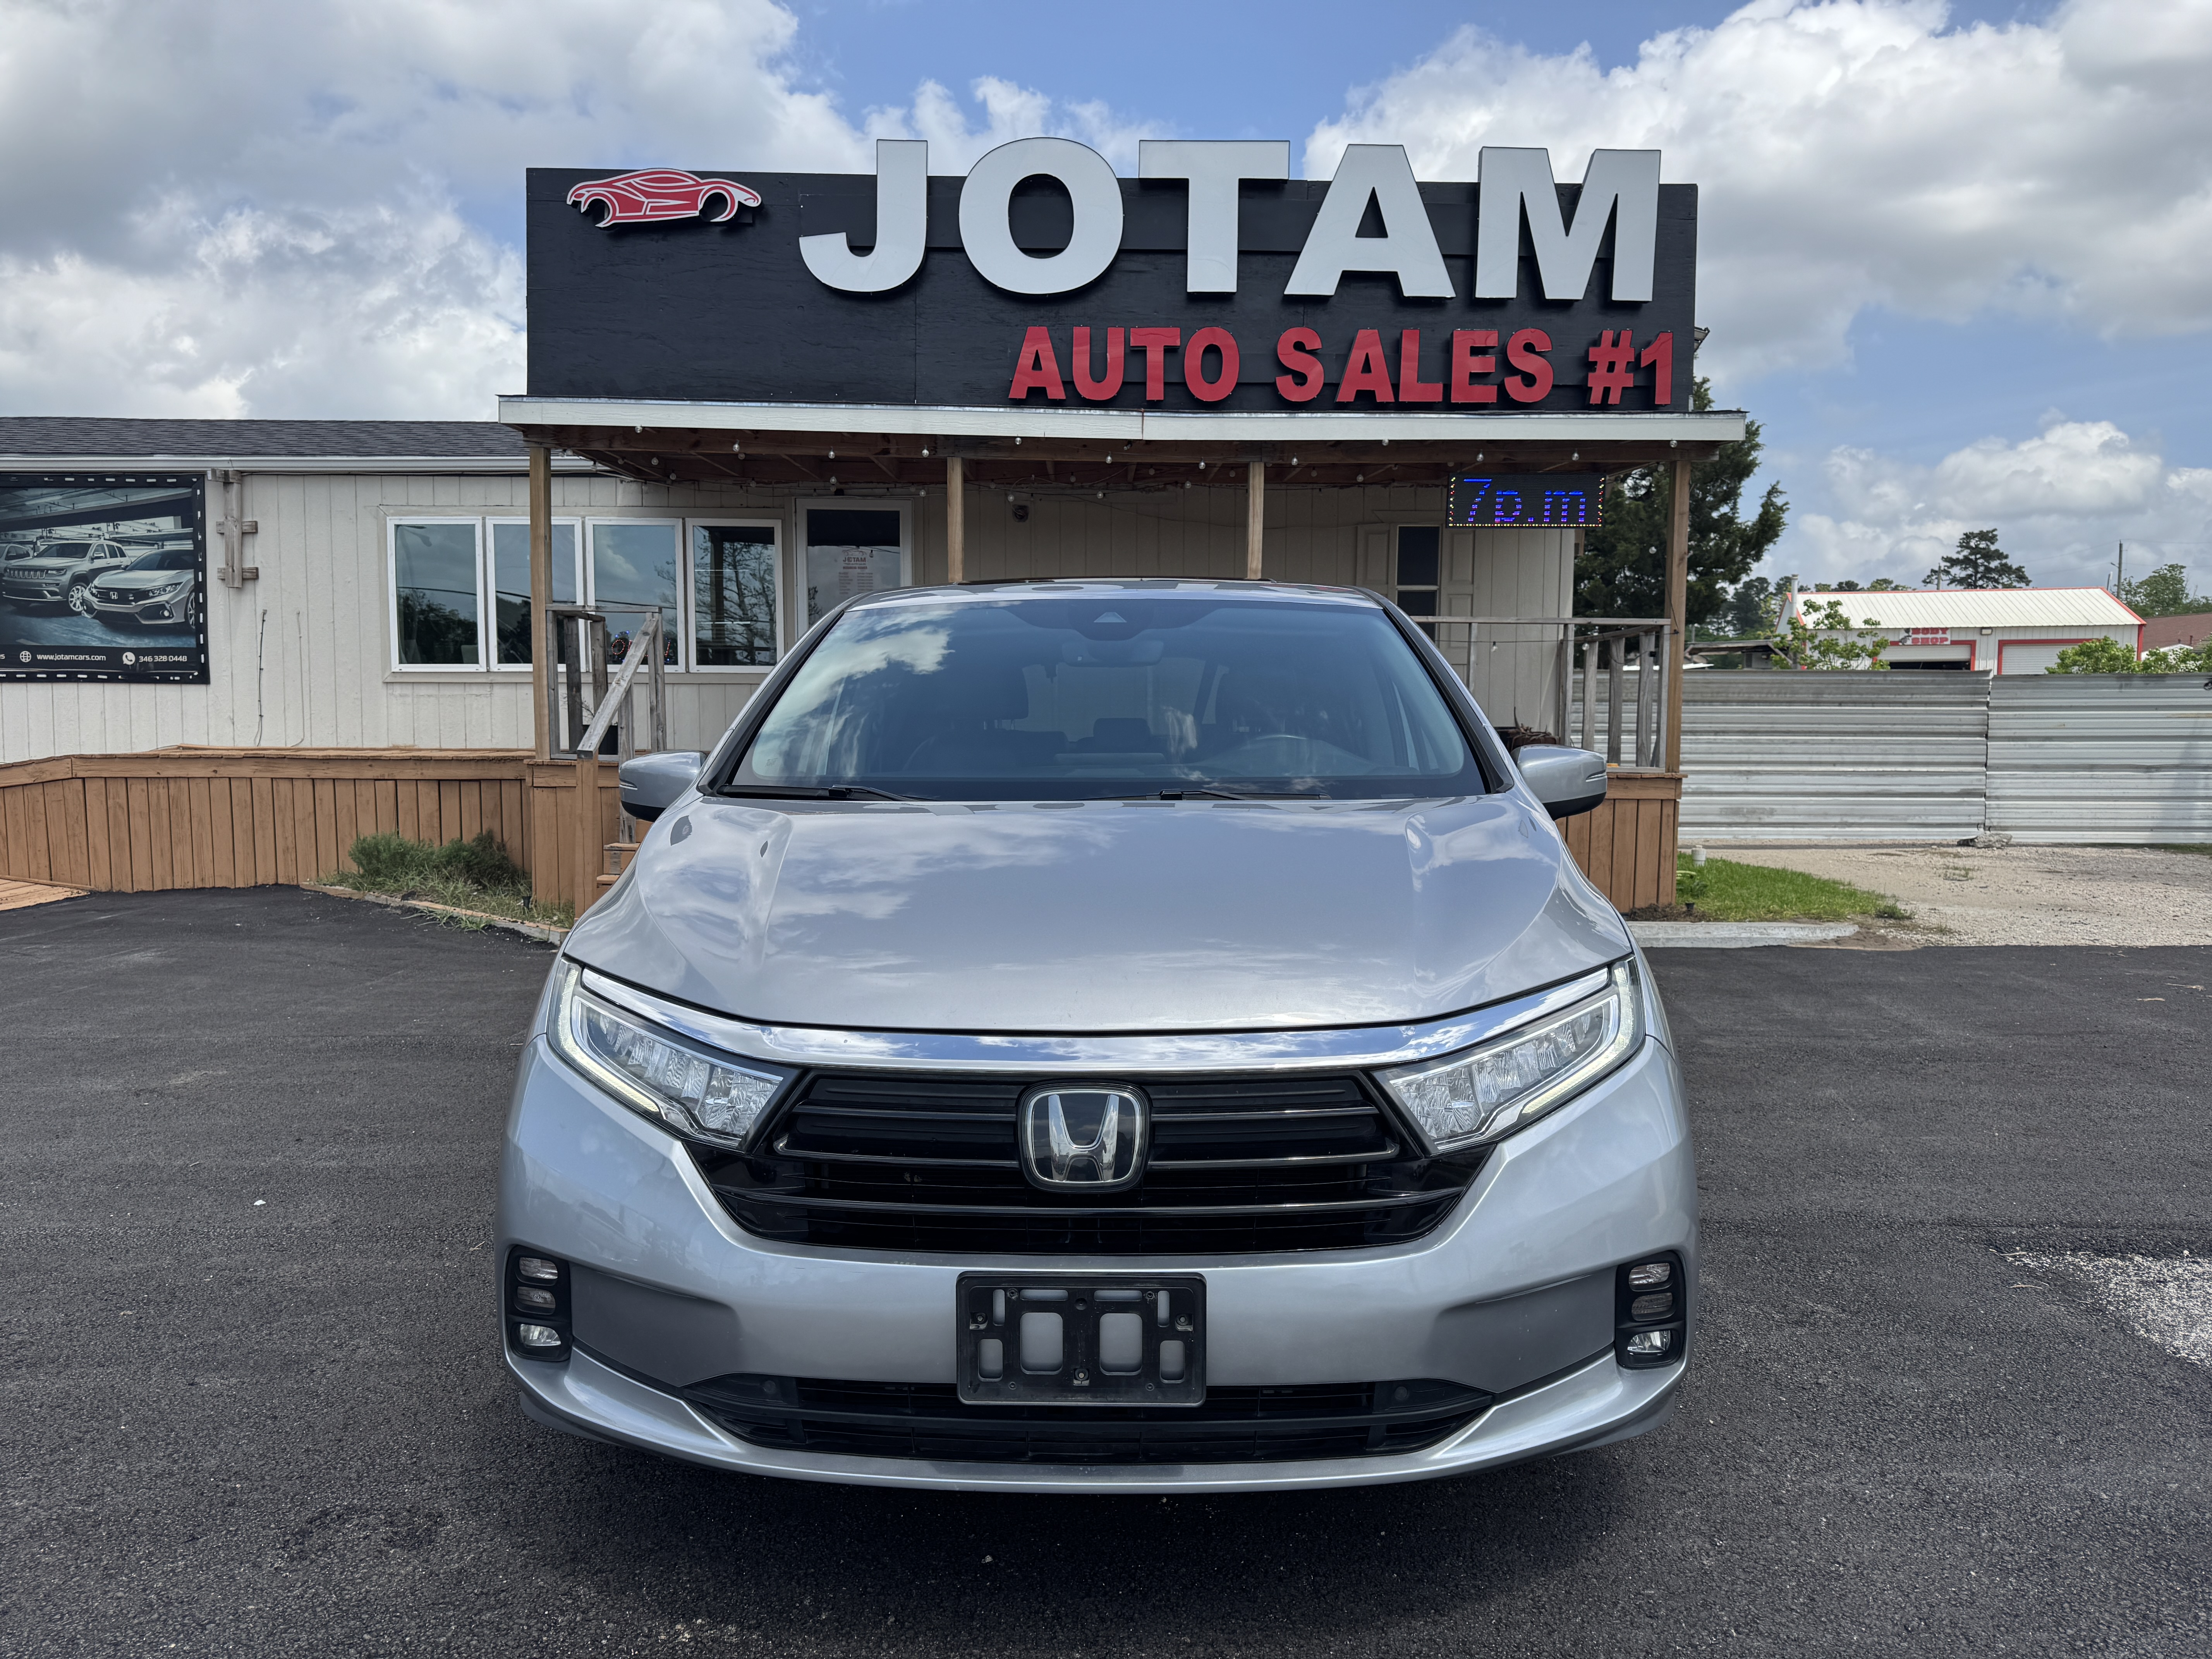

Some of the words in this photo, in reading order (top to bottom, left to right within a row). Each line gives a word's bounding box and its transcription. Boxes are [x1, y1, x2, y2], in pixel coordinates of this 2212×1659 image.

[799, 136, 1662, 303] JOTAM
[1010, 326, 1239, 401] AUTO
[1276, 327, 1553, 402] SALES
[1589, 330, 1673, 404] #1
[37, 653, 106, 661] www.jotamcars.com
